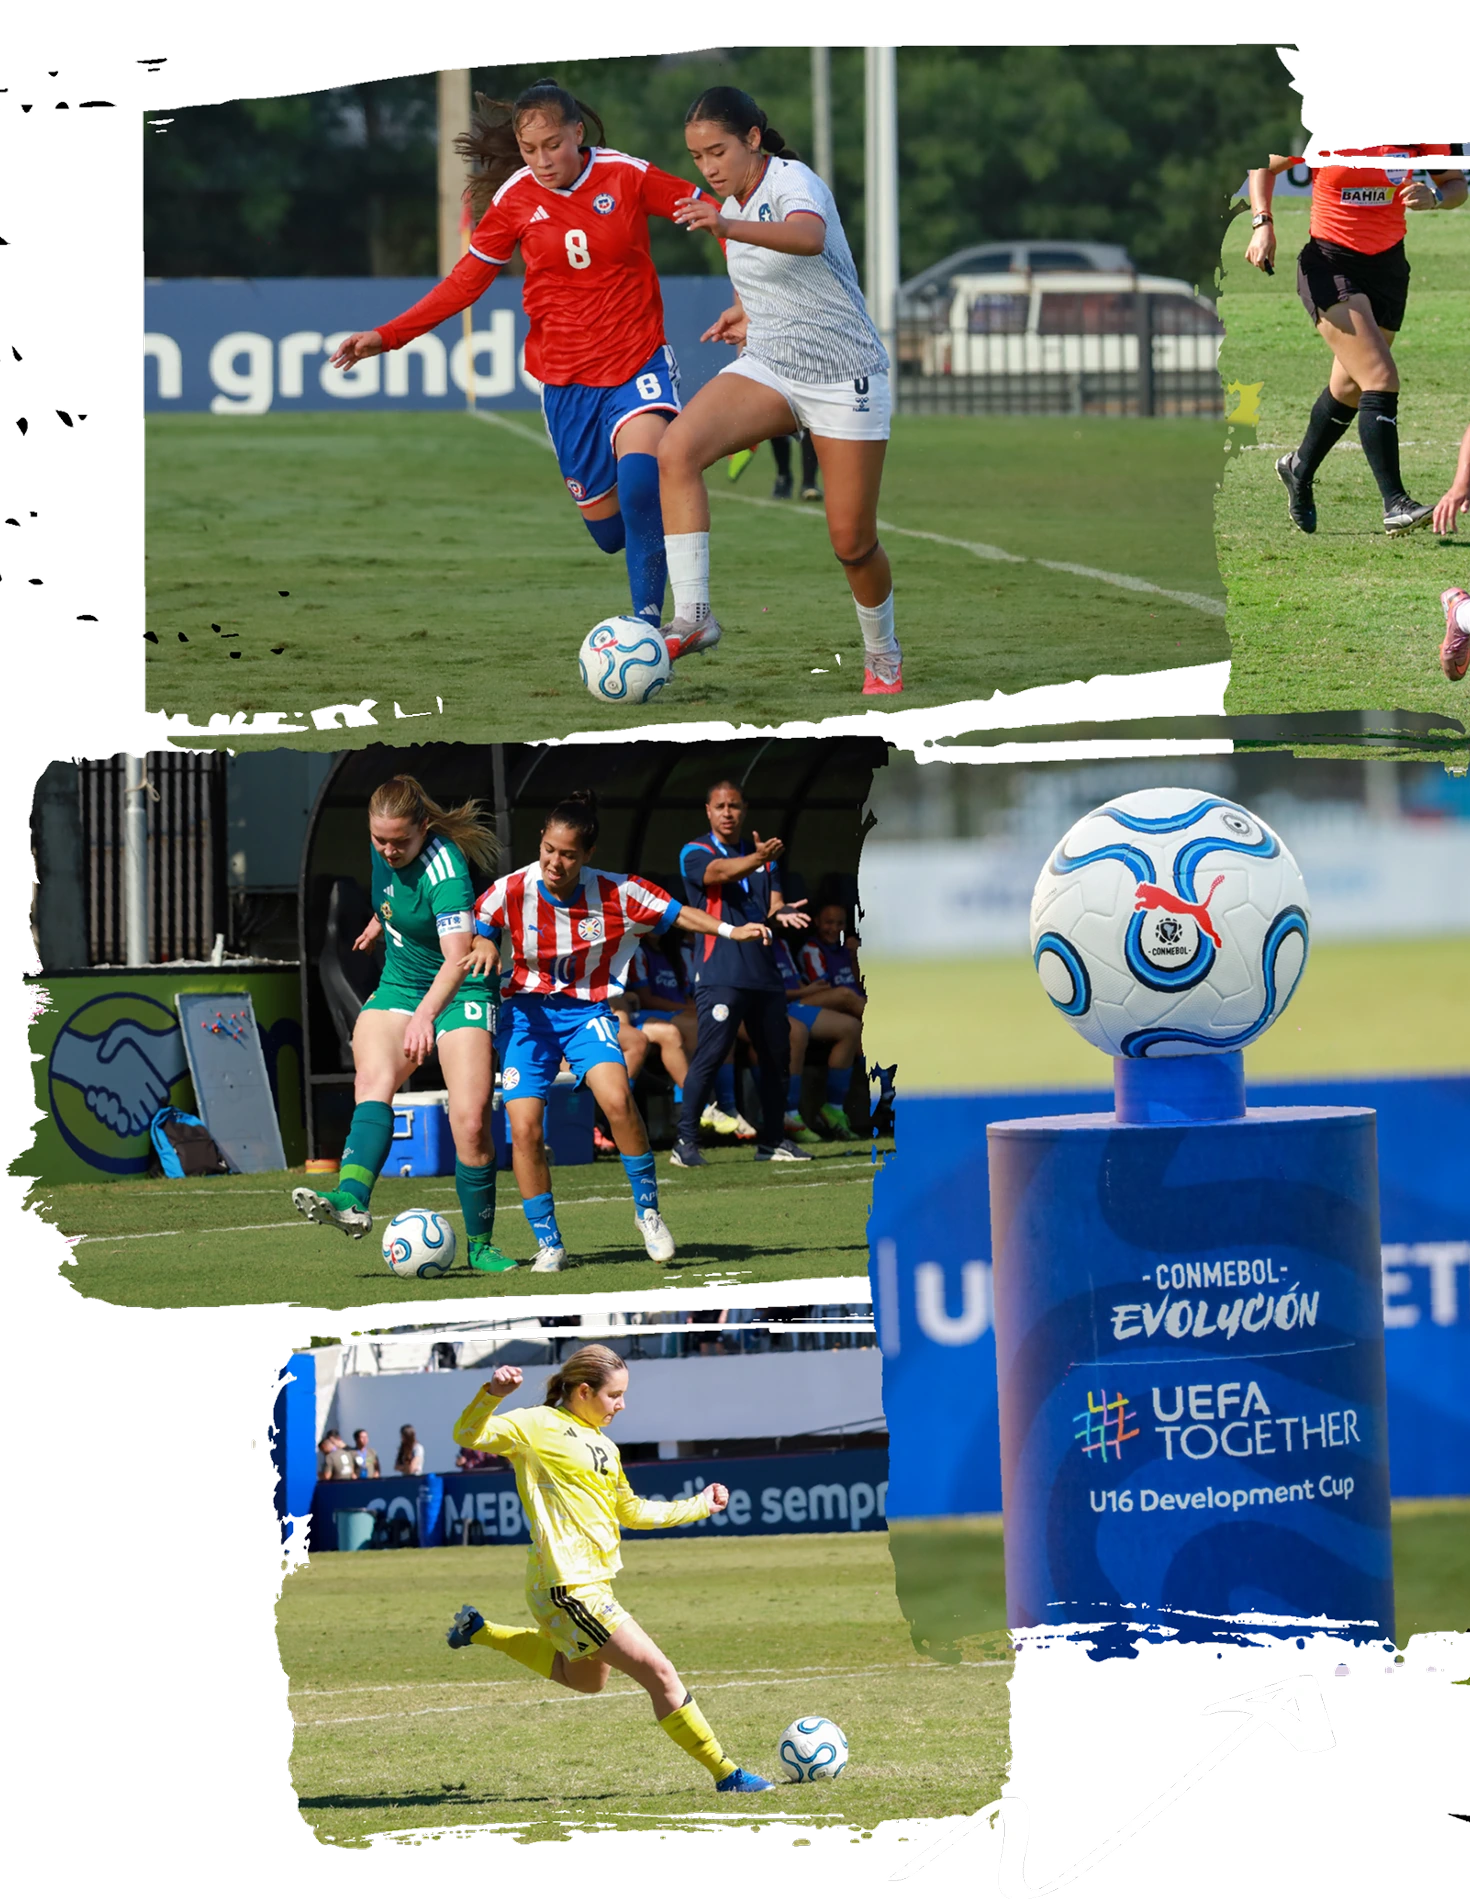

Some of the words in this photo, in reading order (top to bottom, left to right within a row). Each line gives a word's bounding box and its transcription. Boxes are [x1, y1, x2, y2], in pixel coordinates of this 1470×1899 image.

[1341, 190, 1386, 202] BAHIA
[564, 229, 591, 269] 8
[635, 373, 662, 401] 8
[1110, 1281, 1320, 1341] EVOLUCIÓN
[1151, 1381, 1271, 1423] UEFA
[1155, 1409, 1361, 1461] TOGETHER
[585, 1442, 609, 1476] 12
[1090, 1489, 1134, 1513] U16
[1140, 1479, 1315, 1513] Development
[1318, 1475, 1354, 1500] Cup
